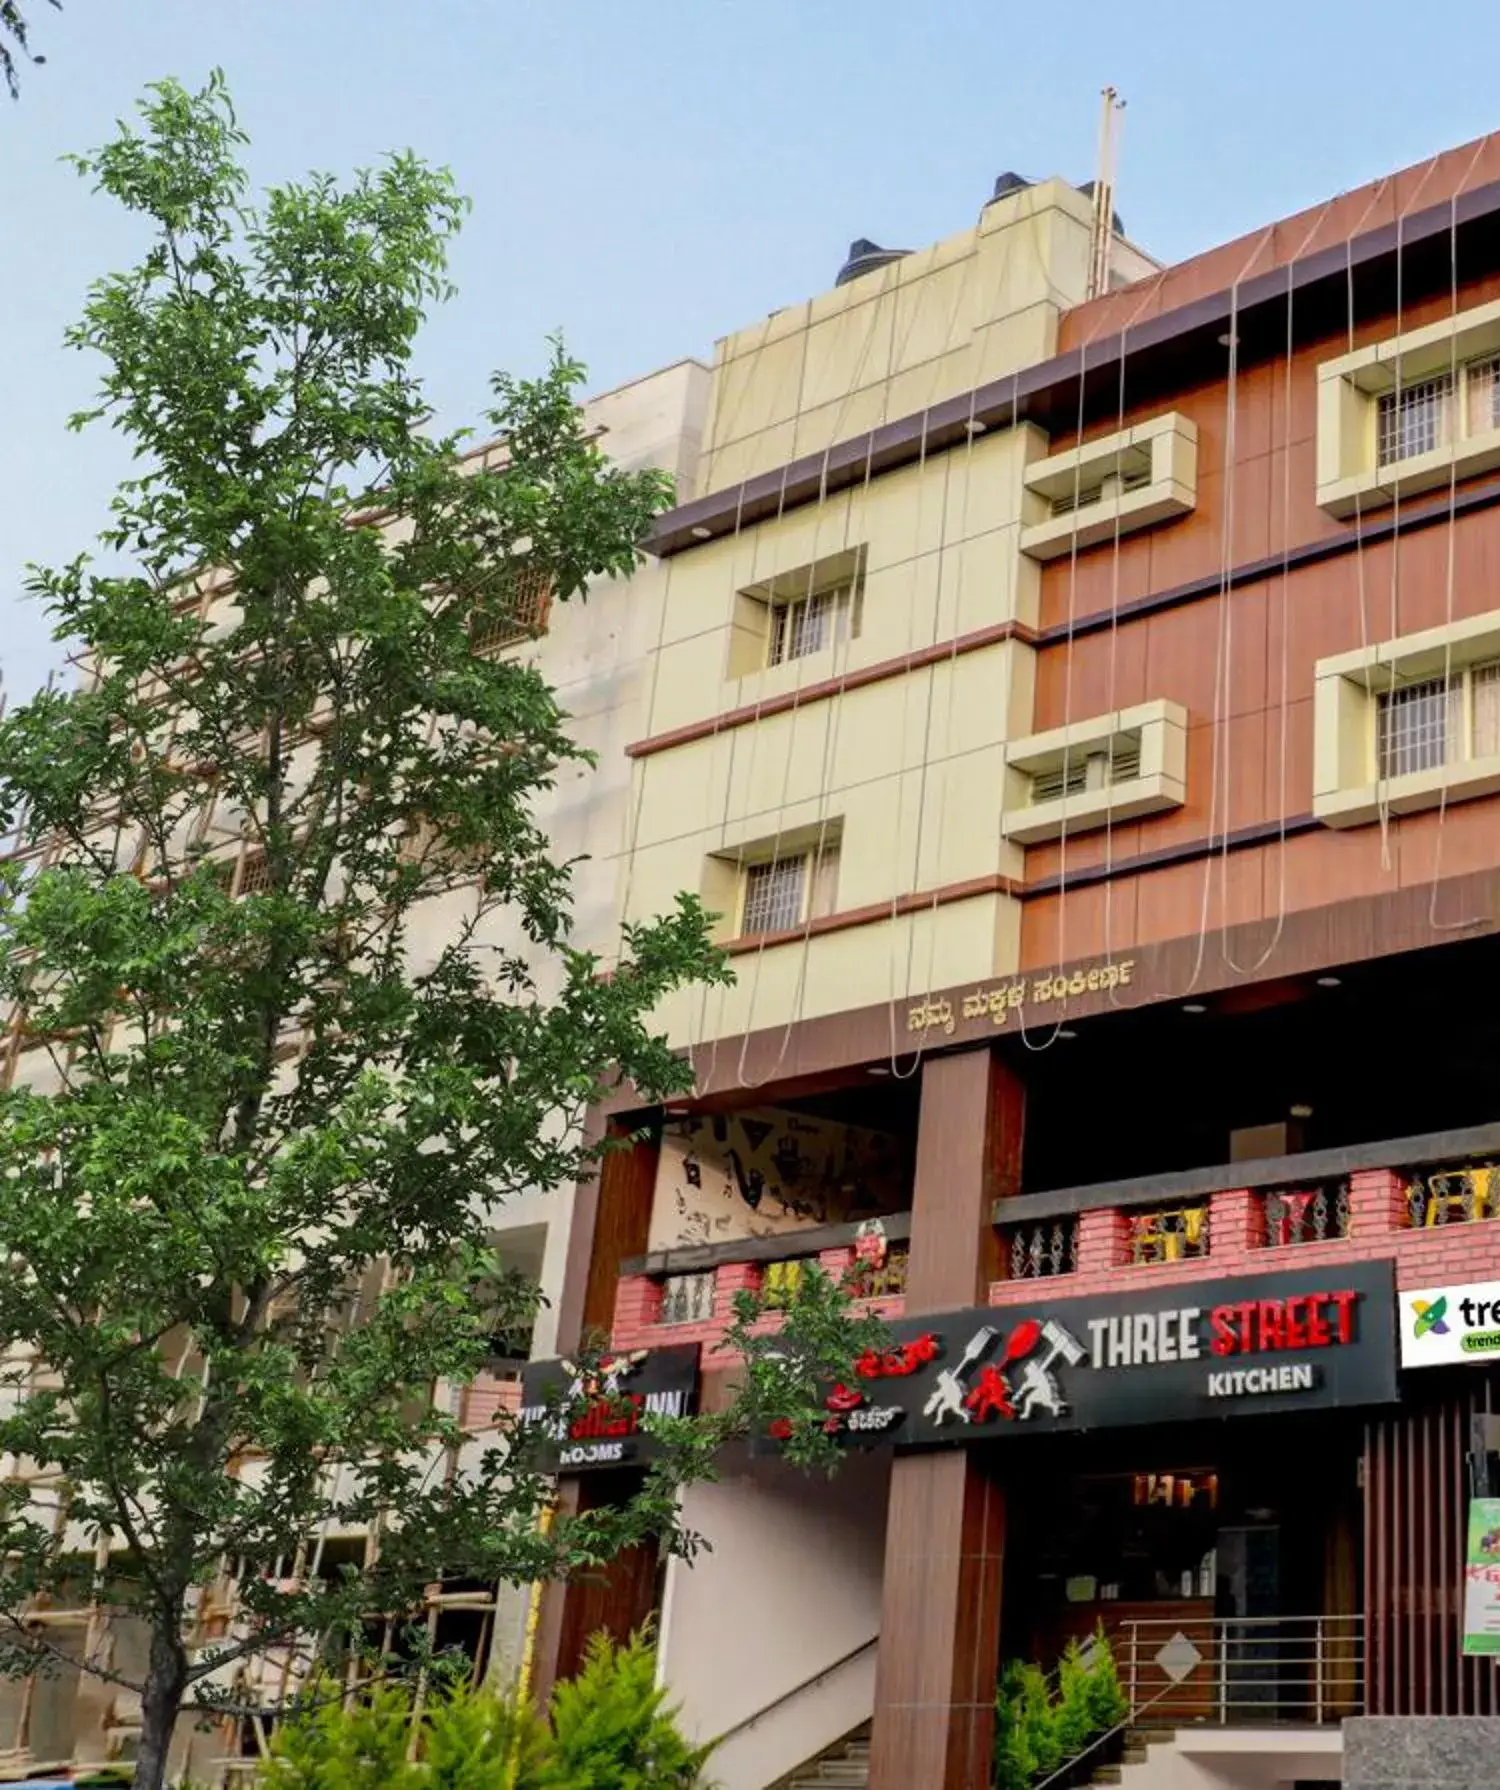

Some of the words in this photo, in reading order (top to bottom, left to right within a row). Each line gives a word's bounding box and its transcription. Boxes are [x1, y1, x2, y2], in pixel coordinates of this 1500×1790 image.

[1087, 1307, 1201, 1369] THREE
[1210, 1290, 1357, 1356] STREET
[1207, 1364, 1313, 1397] KITCHEN
